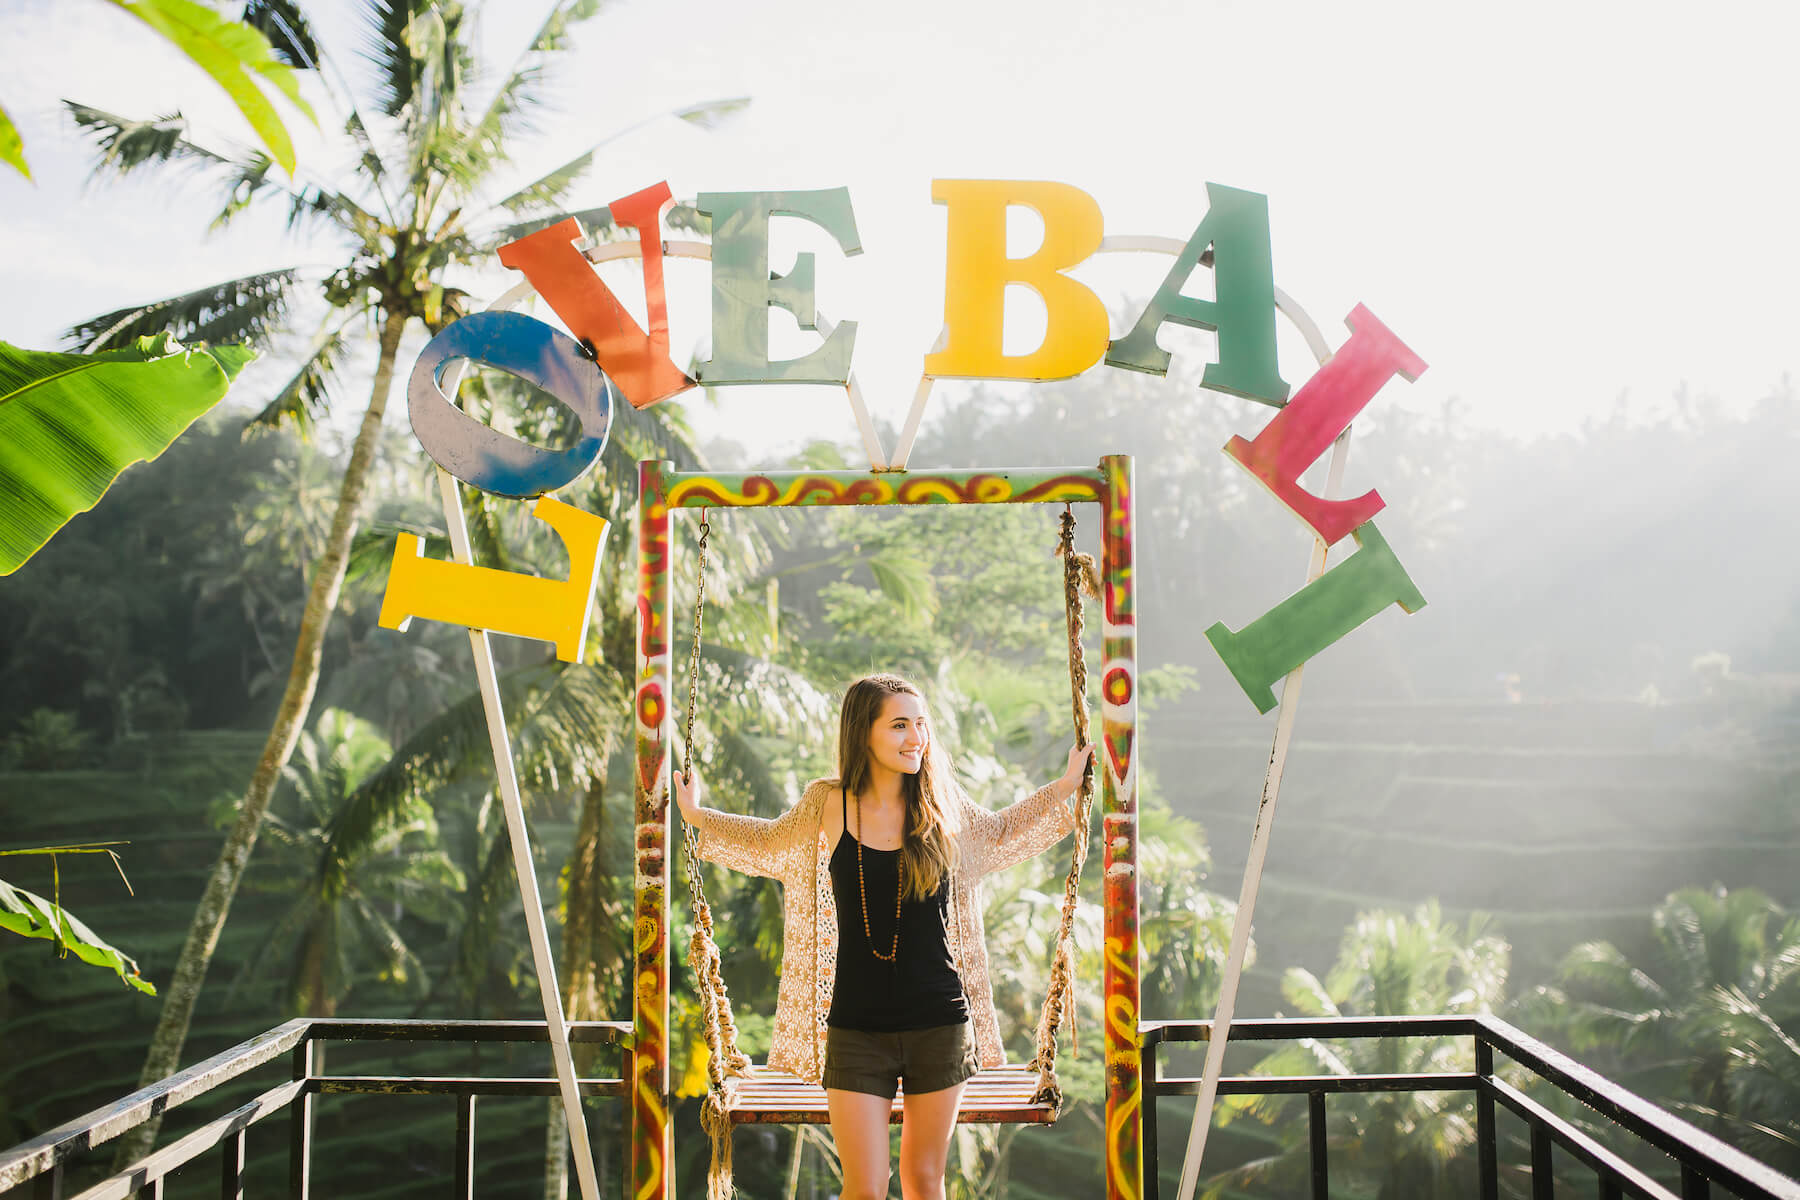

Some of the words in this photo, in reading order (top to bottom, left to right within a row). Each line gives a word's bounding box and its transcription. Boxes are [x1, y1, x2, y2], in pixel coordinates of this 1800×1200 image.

[378, 180, 864, 664] LOVE
[924, 178, 1430, 715] BALI
[635, 594, 667, 888] LOVE
[1103, 581, 1136, 874] LOVE
